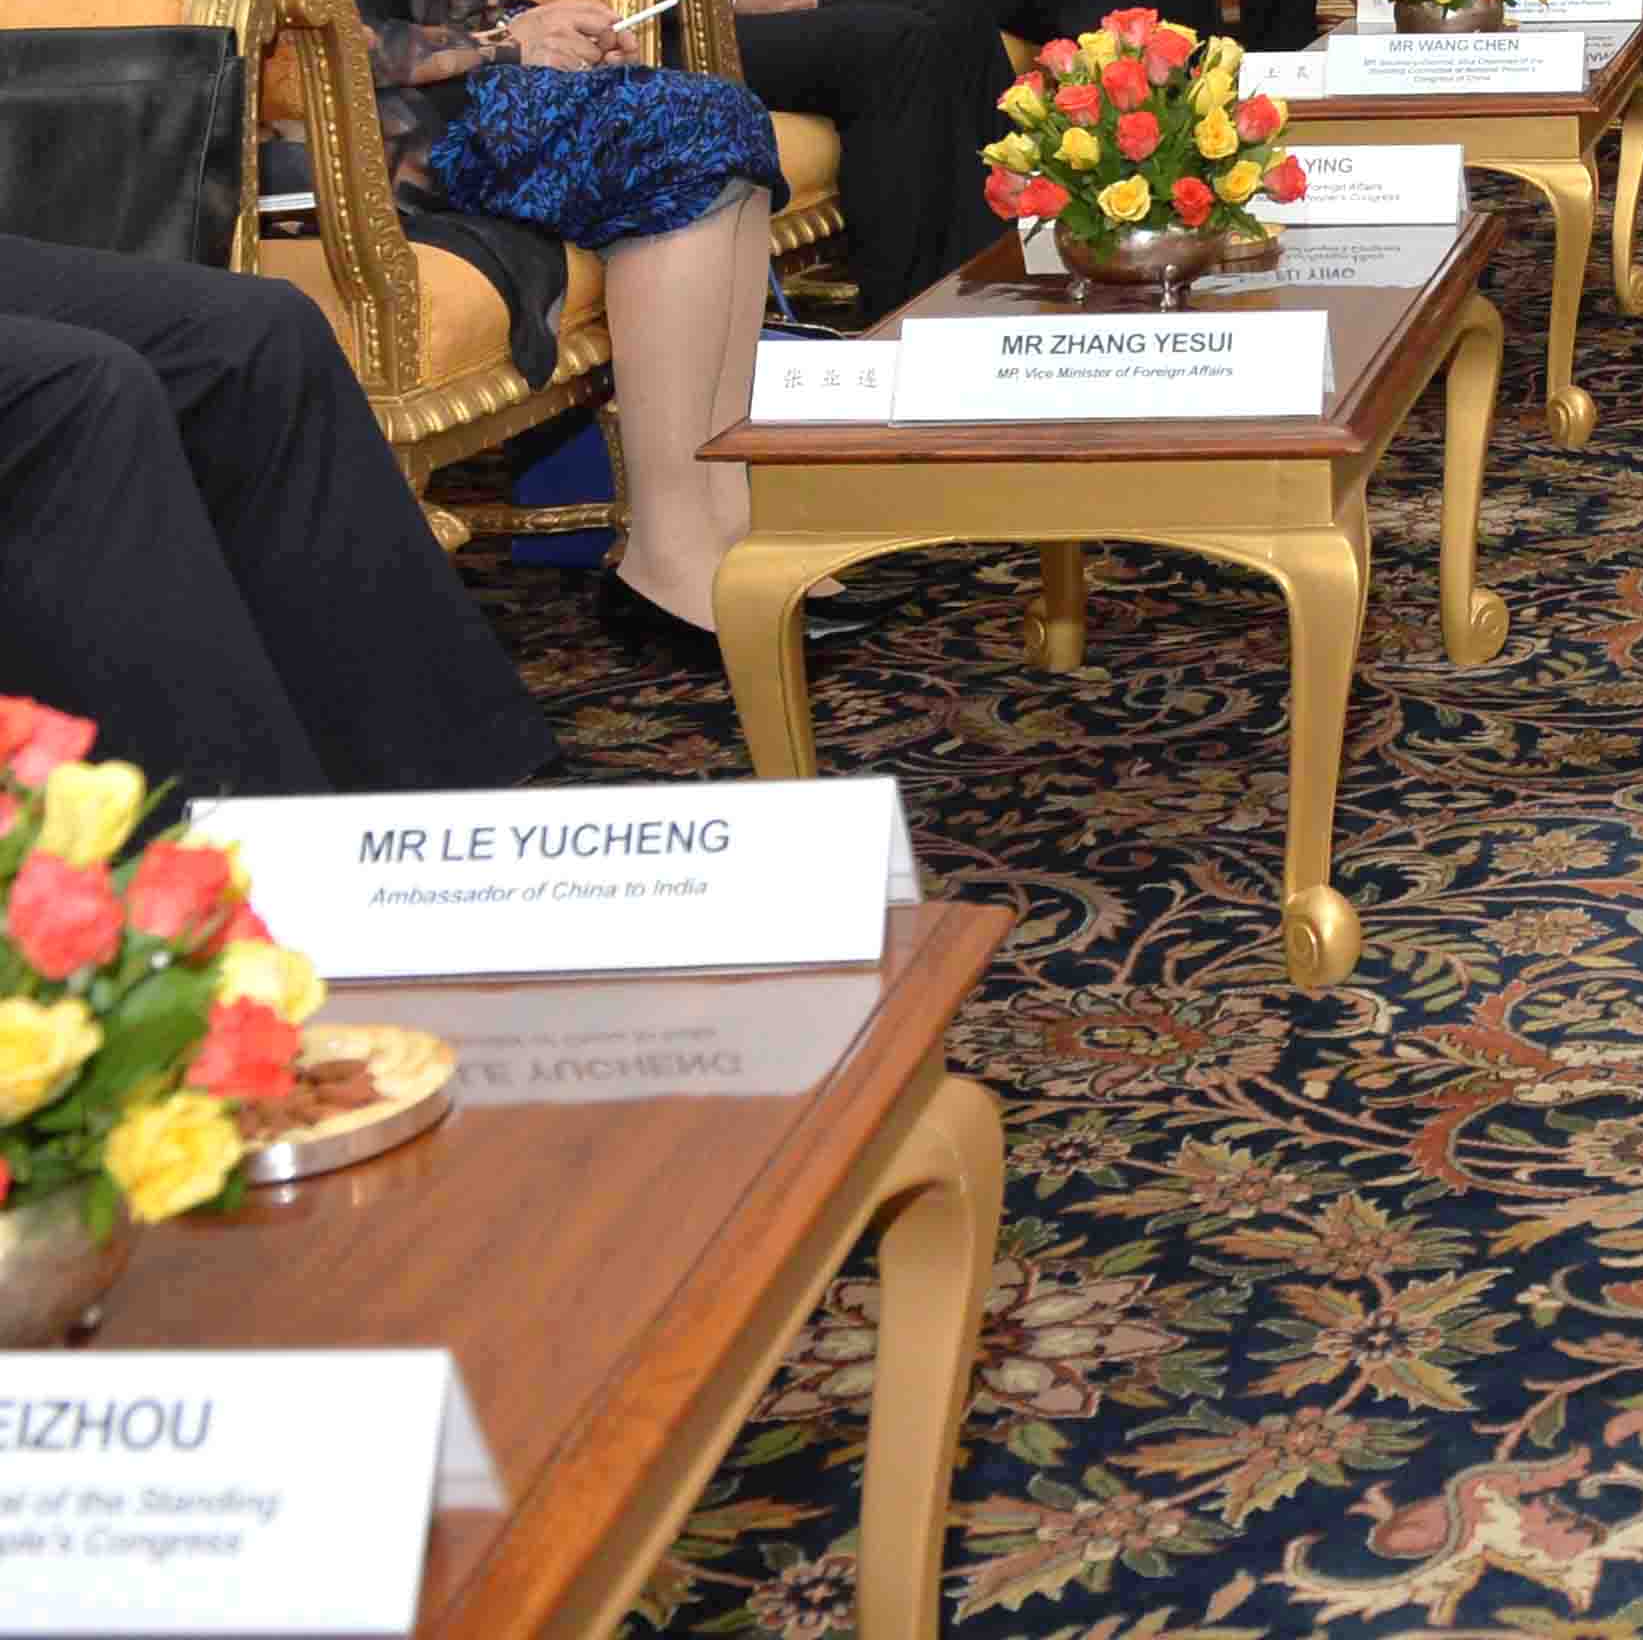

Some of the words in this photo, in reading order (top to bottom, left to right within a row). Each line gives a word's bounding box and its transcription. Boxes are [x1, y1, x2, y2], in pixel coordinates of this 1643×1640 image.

[1389, 38, 1413, 52] MR
[1418, 38, 1470, 52] WANG
[1473, 38, 1519, 51] CHEN
[1305, 157, 1353, 175] YING
[1001, 335, 1043, 355] MR
[1050, 333, 1146, 355] ZHANG
[1154, 332, 1233, 353] YESUI
[1025, 366, 1055, 379] Vice
[1056, 366, 1112, 378] Minister
[1116, 365, 1131, 378] of
[1132, 365, 1186, 379] Foreign
[1187, 364, 1233, 377] Affairs
[359, 828, 427, 863] MR
[441, 826, 496, 862] LE
[509, 819, 731, 861] YUCHENG
[368, 883, 517, 908] Ambassador
[520, 880, 549, 903] of
[551, 878, 618, 901] China
[624, 878, 646, 899] to
[651, 876, 708, 897] India
